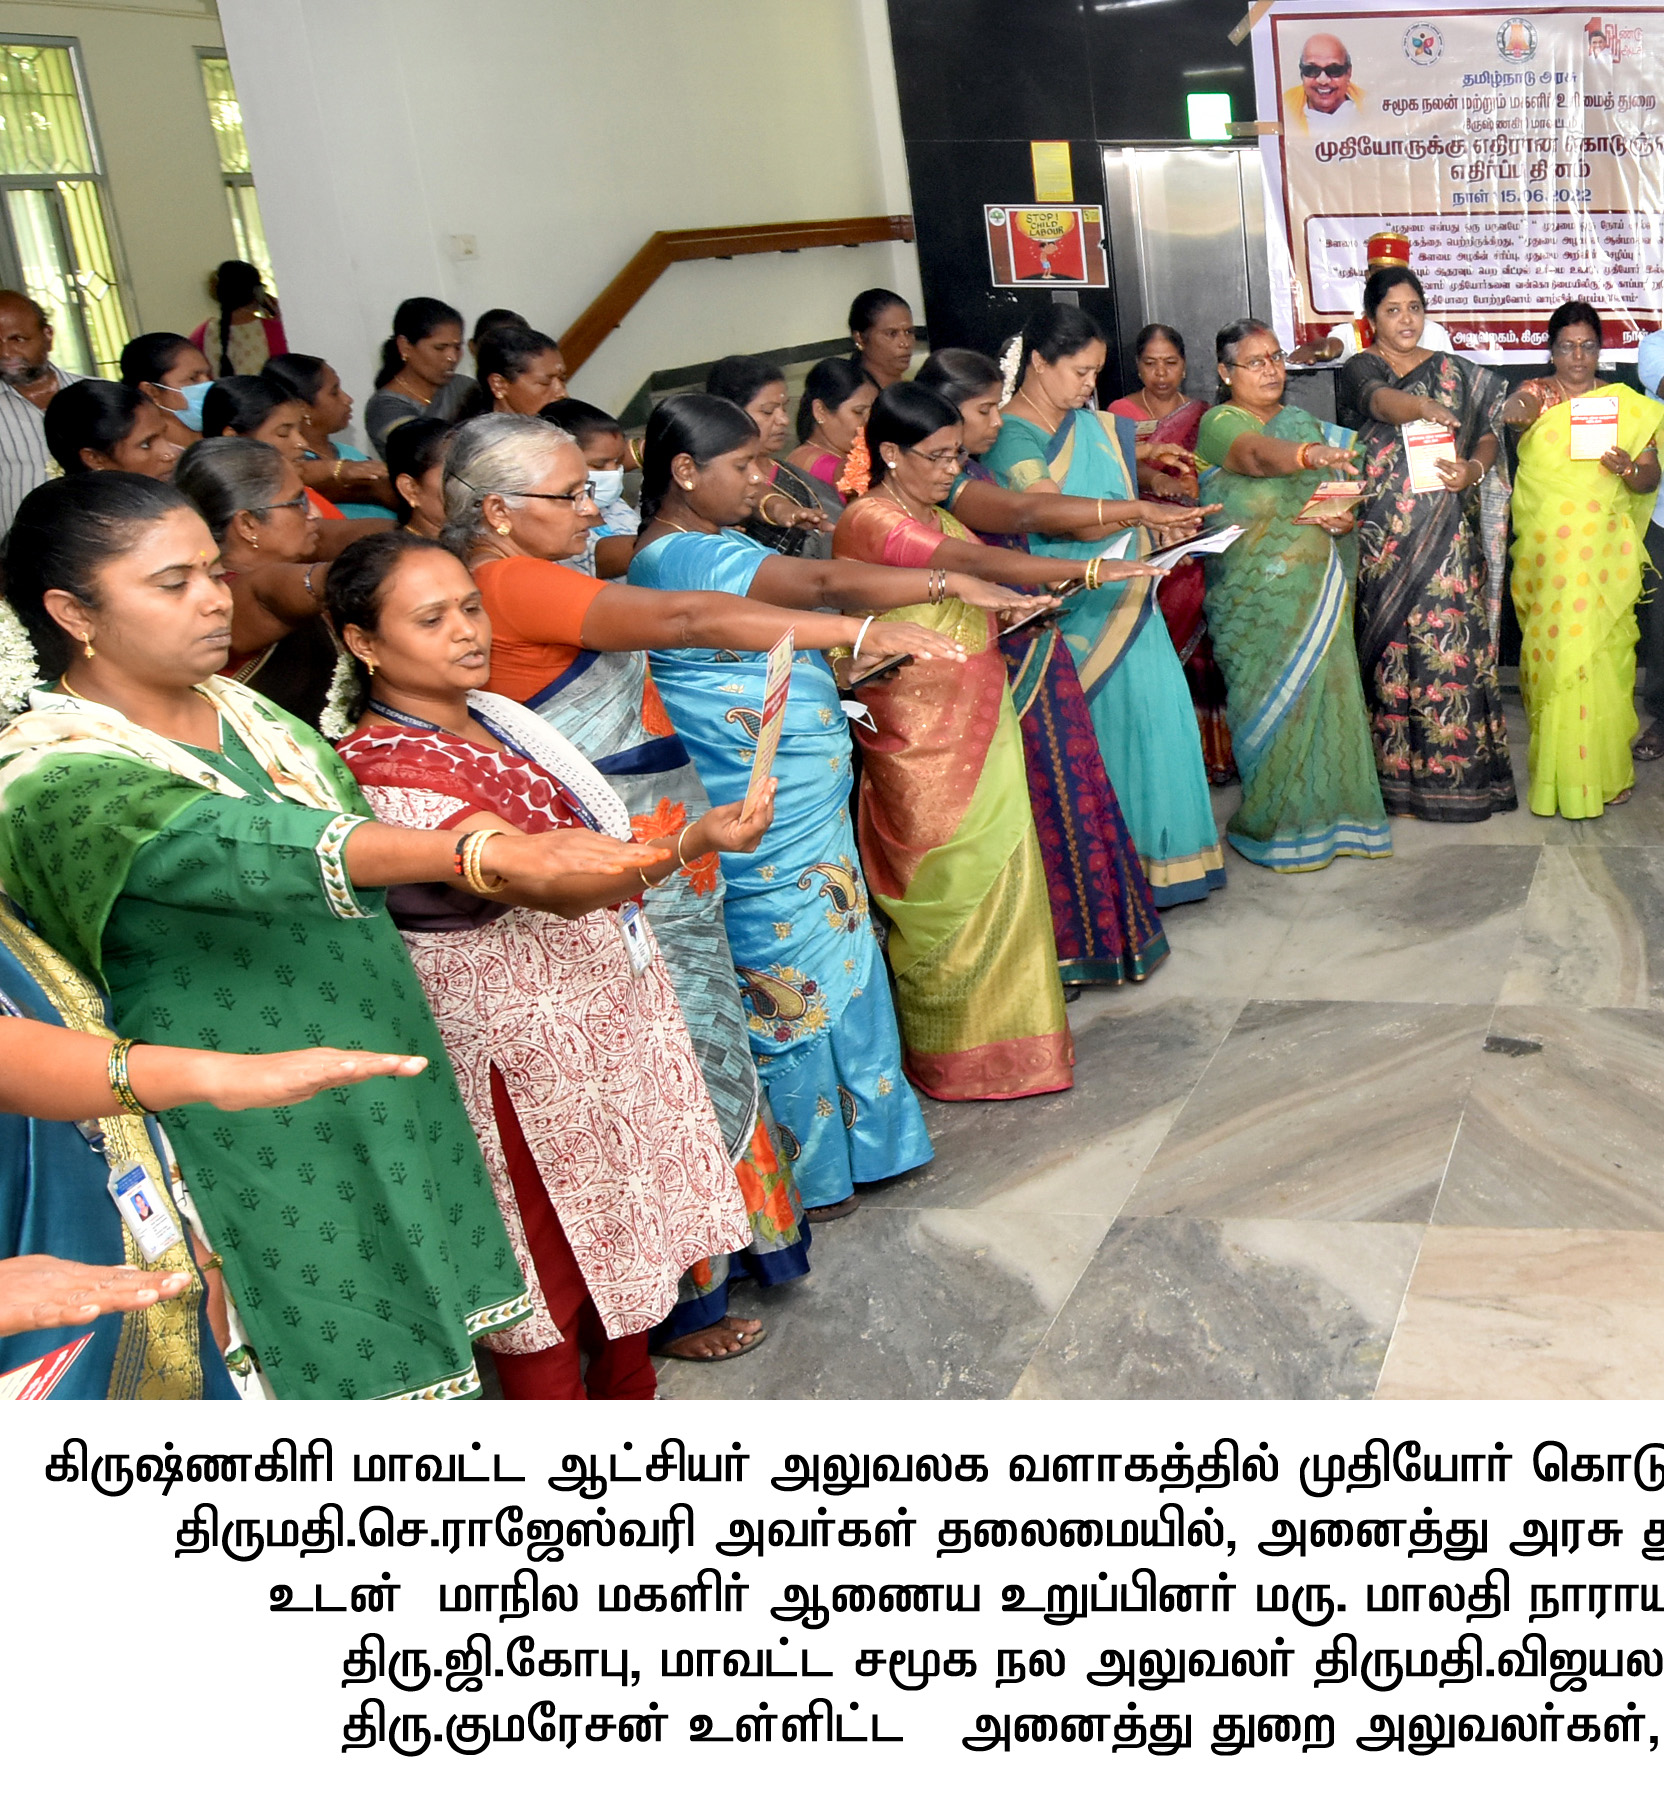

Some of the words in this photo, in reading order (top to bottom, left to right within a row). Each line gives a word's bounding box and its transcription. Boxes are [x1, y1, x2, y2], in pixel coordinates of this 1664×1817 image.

[1462, 70, 1535, 88] தமிழ்நாடு
[1382, 96, 1418, 115] சமூக
[1422, 95, 1458, 114] நலன்
[1618, 94, 1656, 112] துறை
[1315, 134, 1465, 162] முதியோருக்கு
[1029, 226, 1065, 237] LABOUR
[1030, 221, 1058, 230] CHILD
[386, 708, 434, 729] DEPARTMENT
